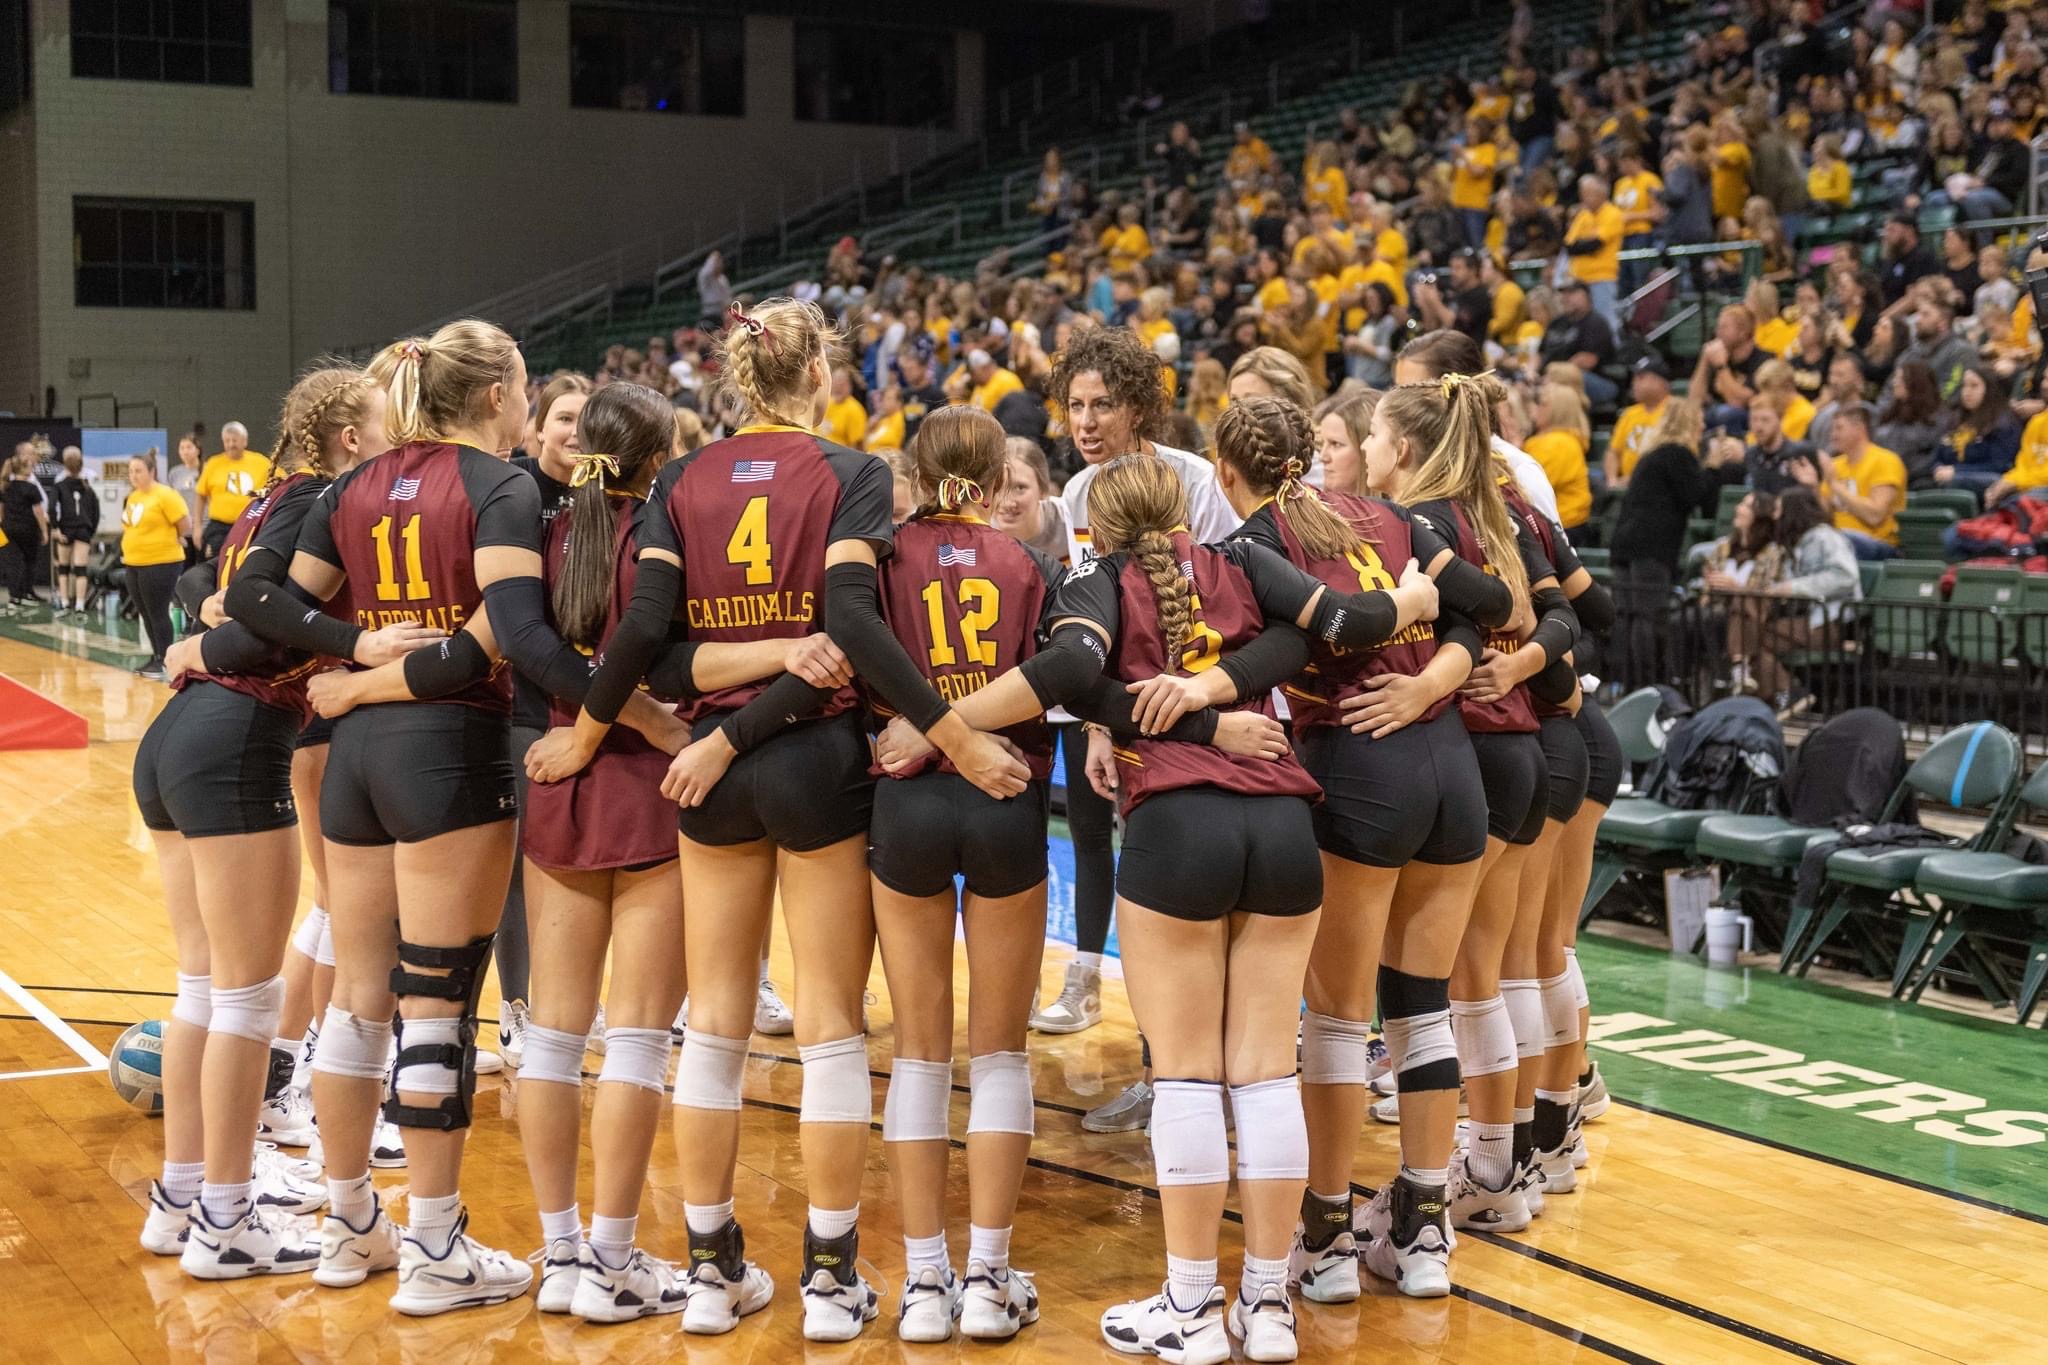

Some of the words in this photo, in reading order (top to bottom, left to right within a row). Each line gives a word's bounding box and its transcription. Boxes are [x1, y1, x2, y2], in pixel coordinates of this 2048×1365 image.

[371, 513, 432, 601] 11
[726, 496, 773, 585] 4
[1343, 541, 1398, 592] 8
[687, 591, 814, 629] CARDINALS
[921, 577, 1000, 667] 12
[1586, 1010, 2048, 1148] AIDERS
